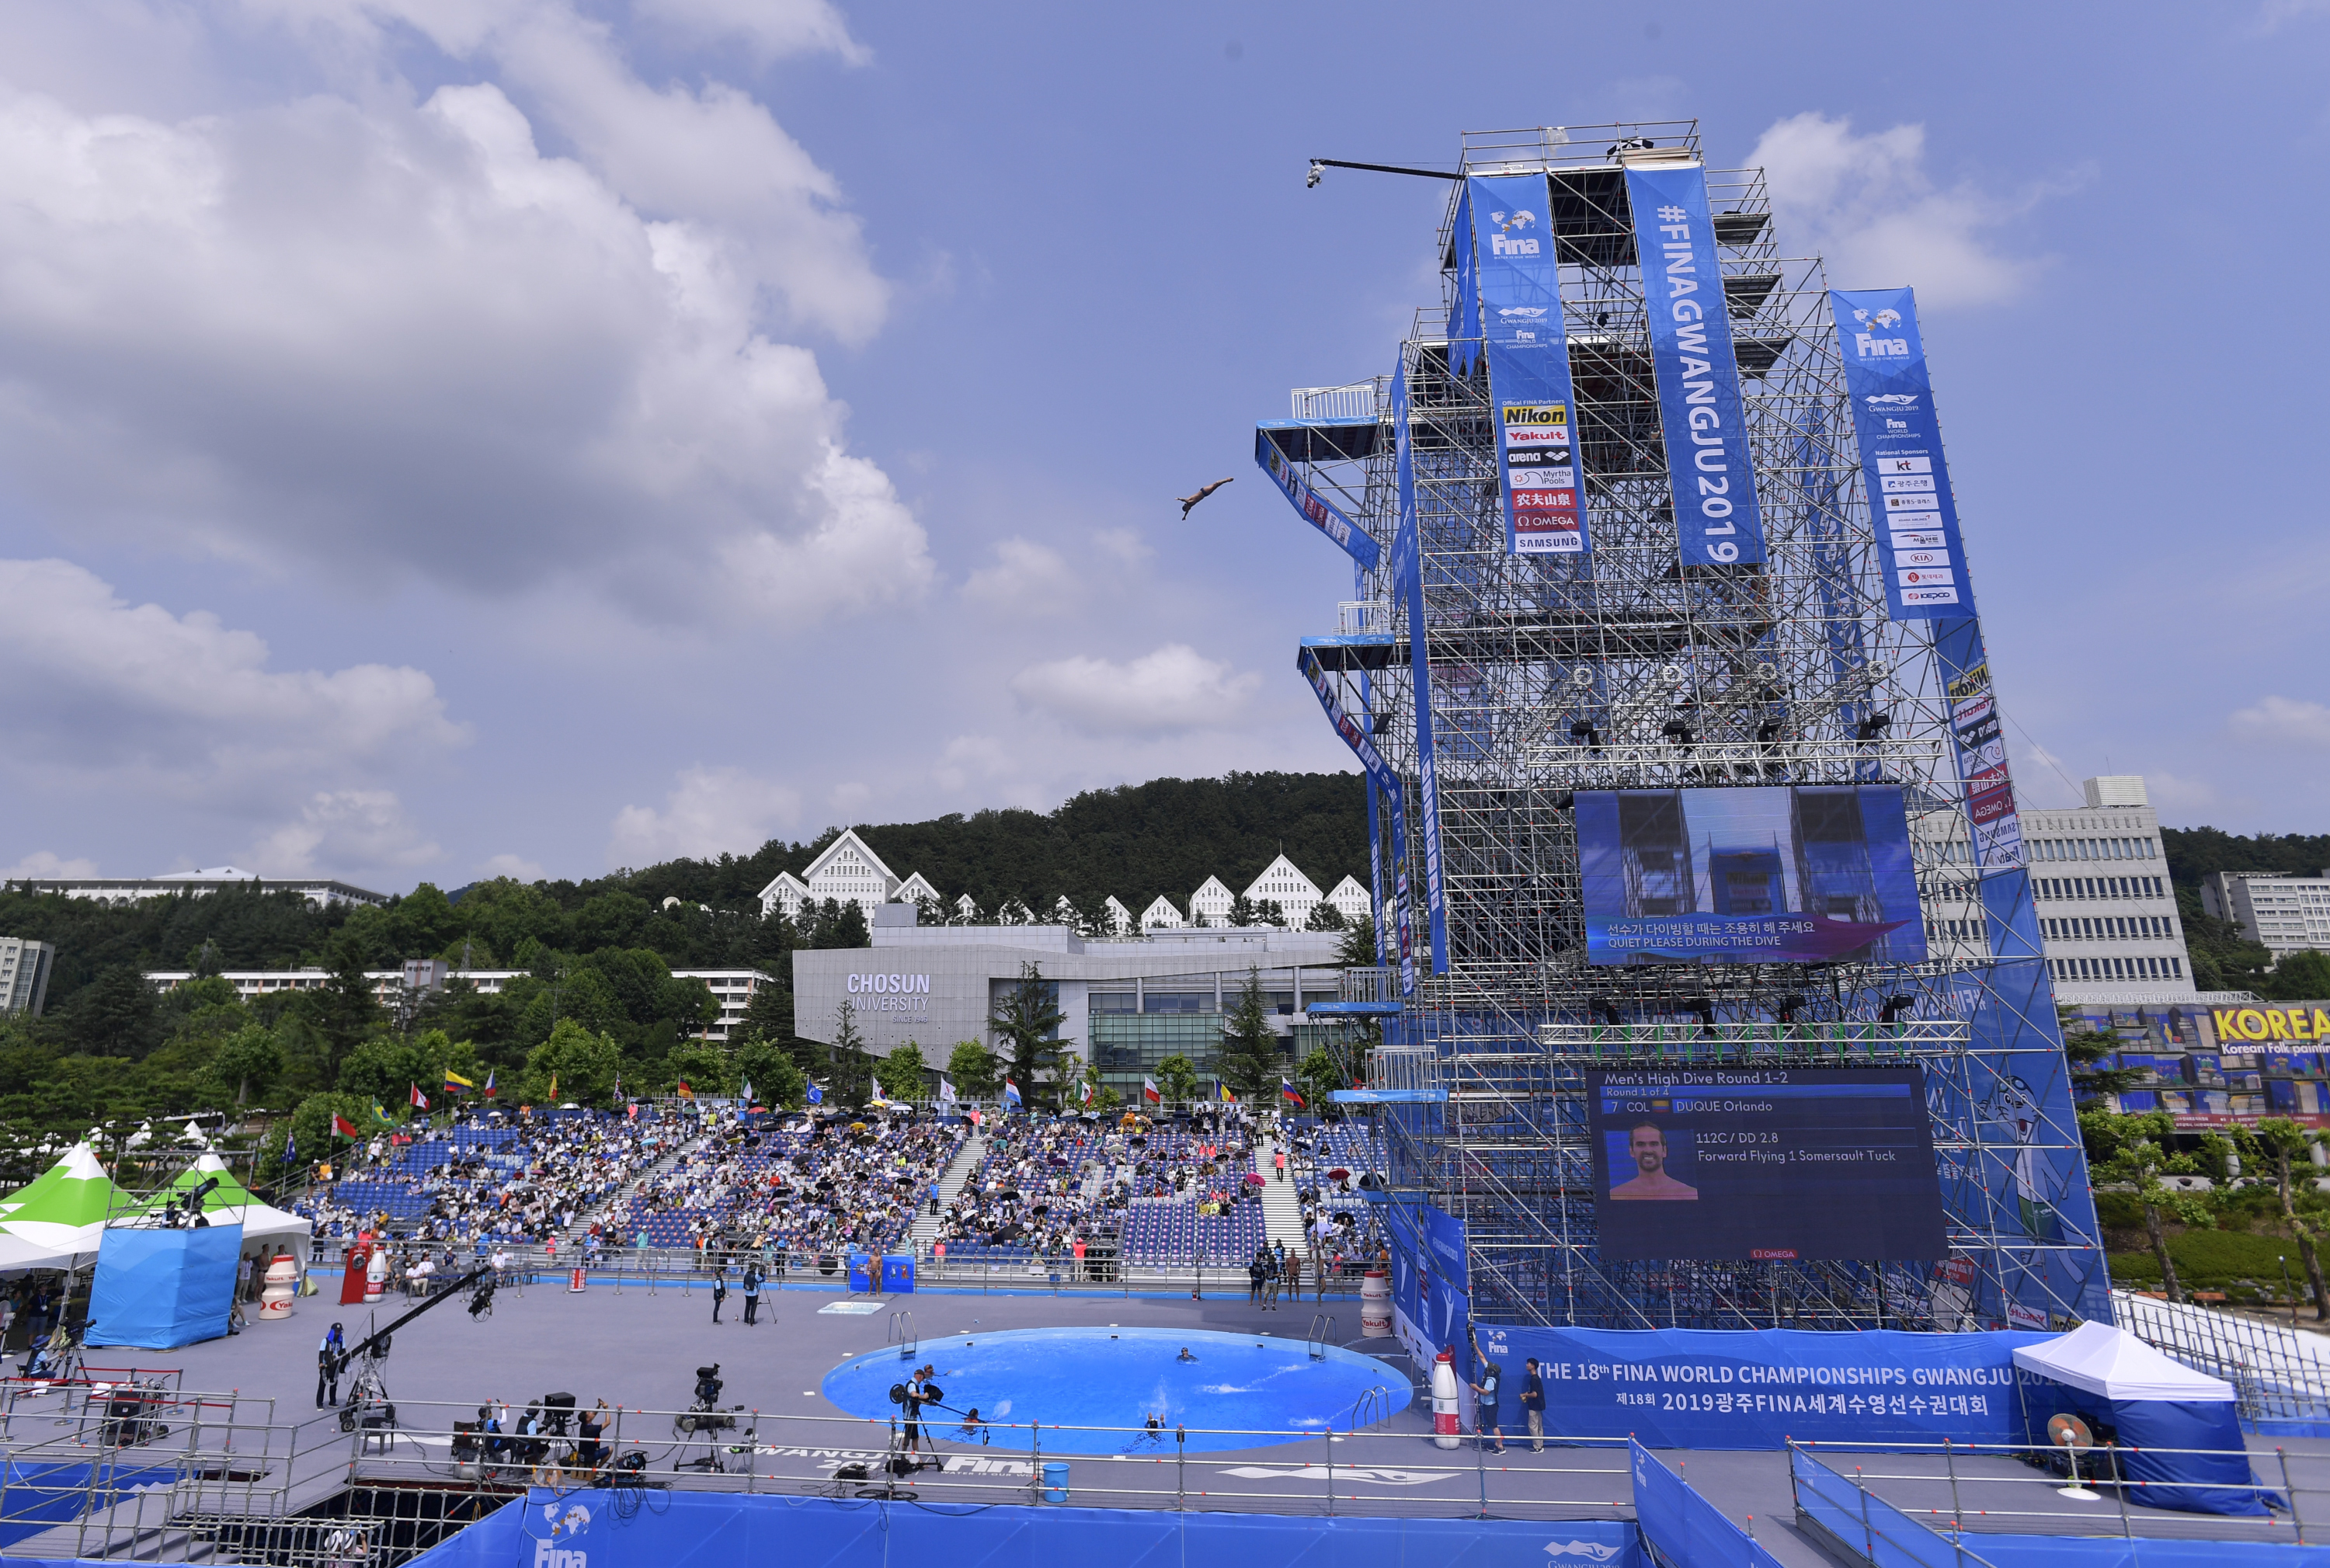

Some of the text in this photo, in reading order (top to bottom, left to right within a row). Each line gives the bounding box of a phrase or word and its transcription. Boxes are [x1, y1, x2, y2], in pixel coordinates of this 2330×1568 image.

[1657, 205, 1739, 563] #FINAGWANGJU2019
[1506, 409, 1565, 423] Nikon
[1509, 431, 1565, 440] Yakult
[1508, 452, 1541, 463] arena
[1896, 461, 1911, 471] kt
[1897, 479, 1928, 488] 광주은행
[1517, 493, 1570, 506] 农夫山泉
[1532, 516, 1574, 526] OMEGA
[1519, 537, 1578, 548] SAMSUNG
[1607, 921, 1815, 937] 선수가 다이빙할 때는 조용히 해 주세요
[1608, 936, 1781, 948] QUIET PLEASE DURING THE DIVE
[847, 973, 930, 993] CHOSUN
[847, 996, 930, 1012] UNIVERSITY
[2214, 1009, 2330, 1040] KOREA
[2221, 1043, 2265, 1055] Korean
[2267, 1041, 2290, 1053] Folk
[1605, 1072, 1789, 1087] Men's High Dive Round 1-2
[1607, 1088, 1638, 1097] Round
[1611, 1100, 1772, 1112] 7 COL DUQUE Orlando
[1696, 1132, 1728, 1144] 112C
[1738, 1132, 1756, 1143] DD
[1759, 1132, 1779, 1143] 2.8
[1698, 1149, 1897, 1165] Forward Flying 1 Somersault Tuck
[1362, 1319, 1386, 1327] Yakult
[1537, 1362, 1572, 1380] THE
[1577, 1363, 1610, 1381] 18th
[1612, 1364, 1658, 1382] FINA
[1661, 1365, 1734, 1384] WORLD
[1738, 1365, 1907, 1385] CHAMPIONSHIPS
[1912, 1368, 2014, 1386] GWANGJU
[1616, 1392, 1989, 1417] 제18회 2019광주FINA세계수영선수권대회
